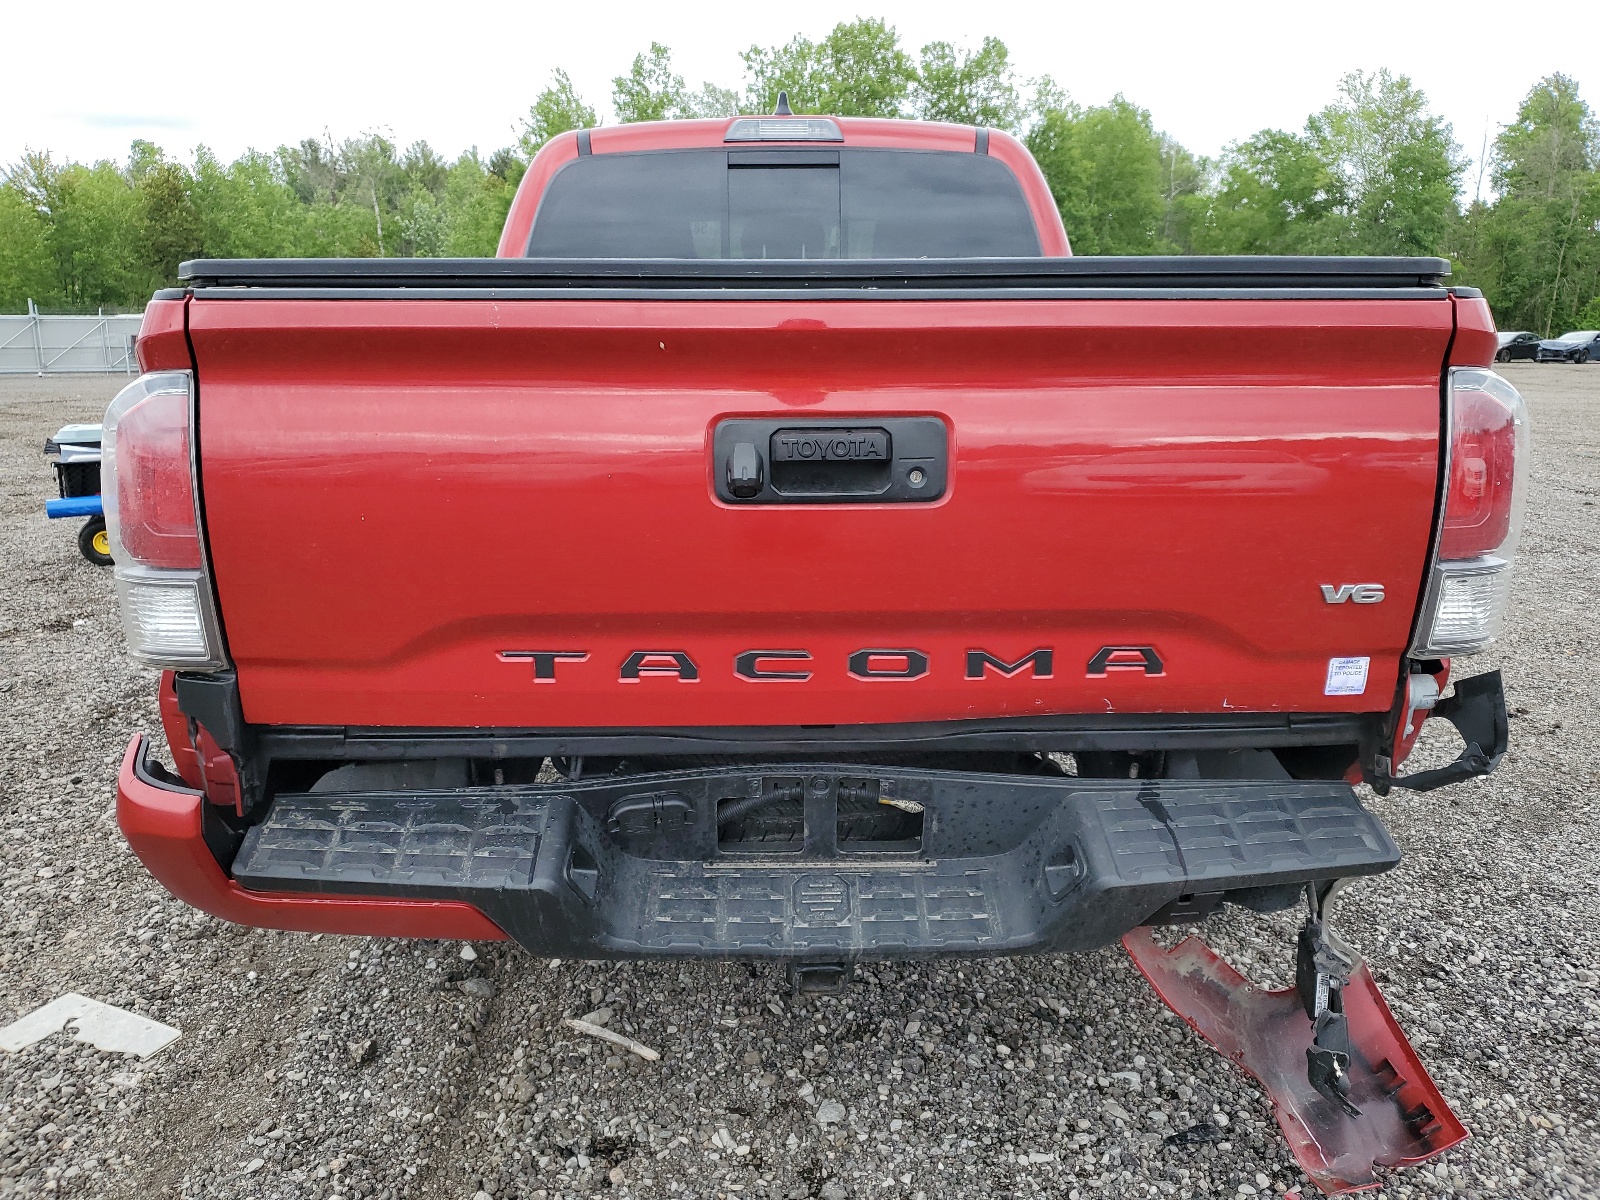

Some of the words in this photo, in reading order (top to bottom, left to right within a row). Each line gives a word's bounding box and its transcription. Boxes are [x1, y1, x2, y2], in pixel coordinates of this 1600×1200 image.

[782, 438, 882, 458] TOYOTA
[1320, 584, 1385, 604] V6
[497, 646, 1166, 682] TACOMA
